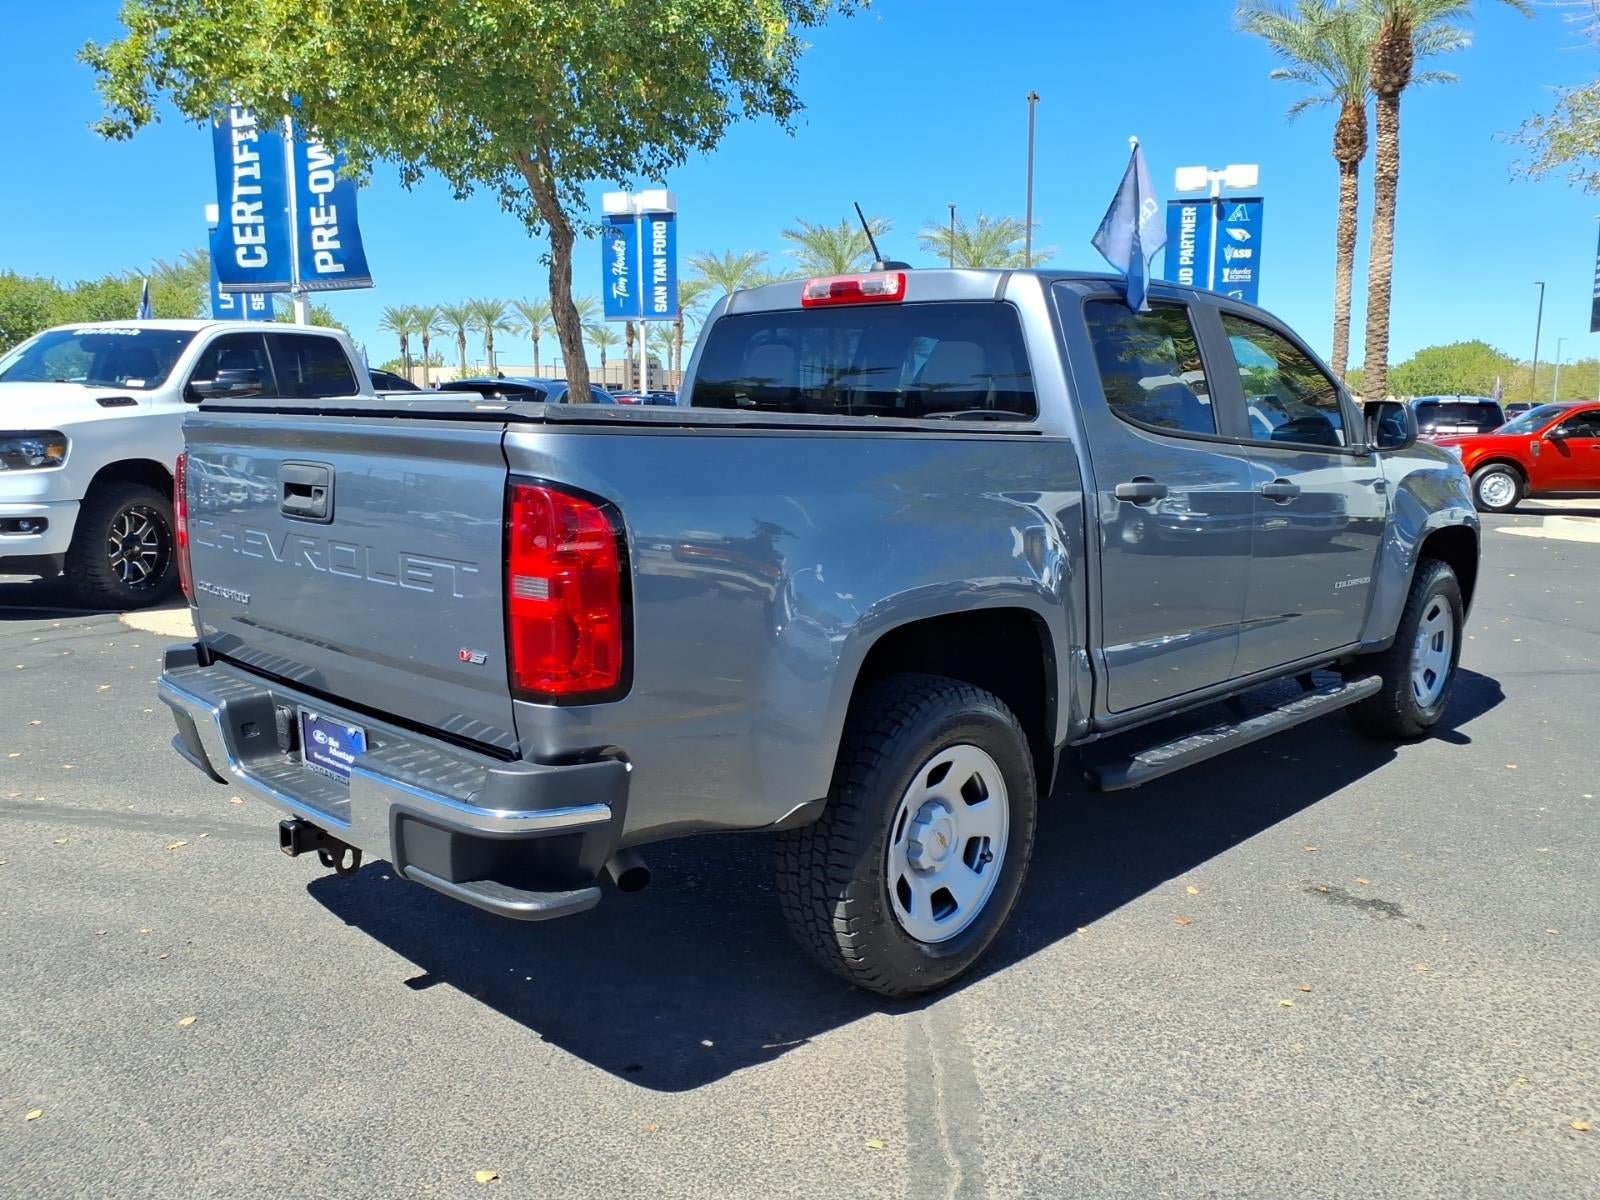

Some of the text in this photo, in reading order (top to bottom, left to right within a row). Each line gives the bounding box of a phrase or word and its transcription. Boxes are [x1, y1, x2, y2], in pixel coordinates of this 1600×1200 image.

[231, 92, 268, 268] CERTIFIE
[652, 221, 668, 313] SAN TAN FORD
[1180, 207, 1197, 265] PARTNER
[193, 518, 479, 598] CHEVROLET
